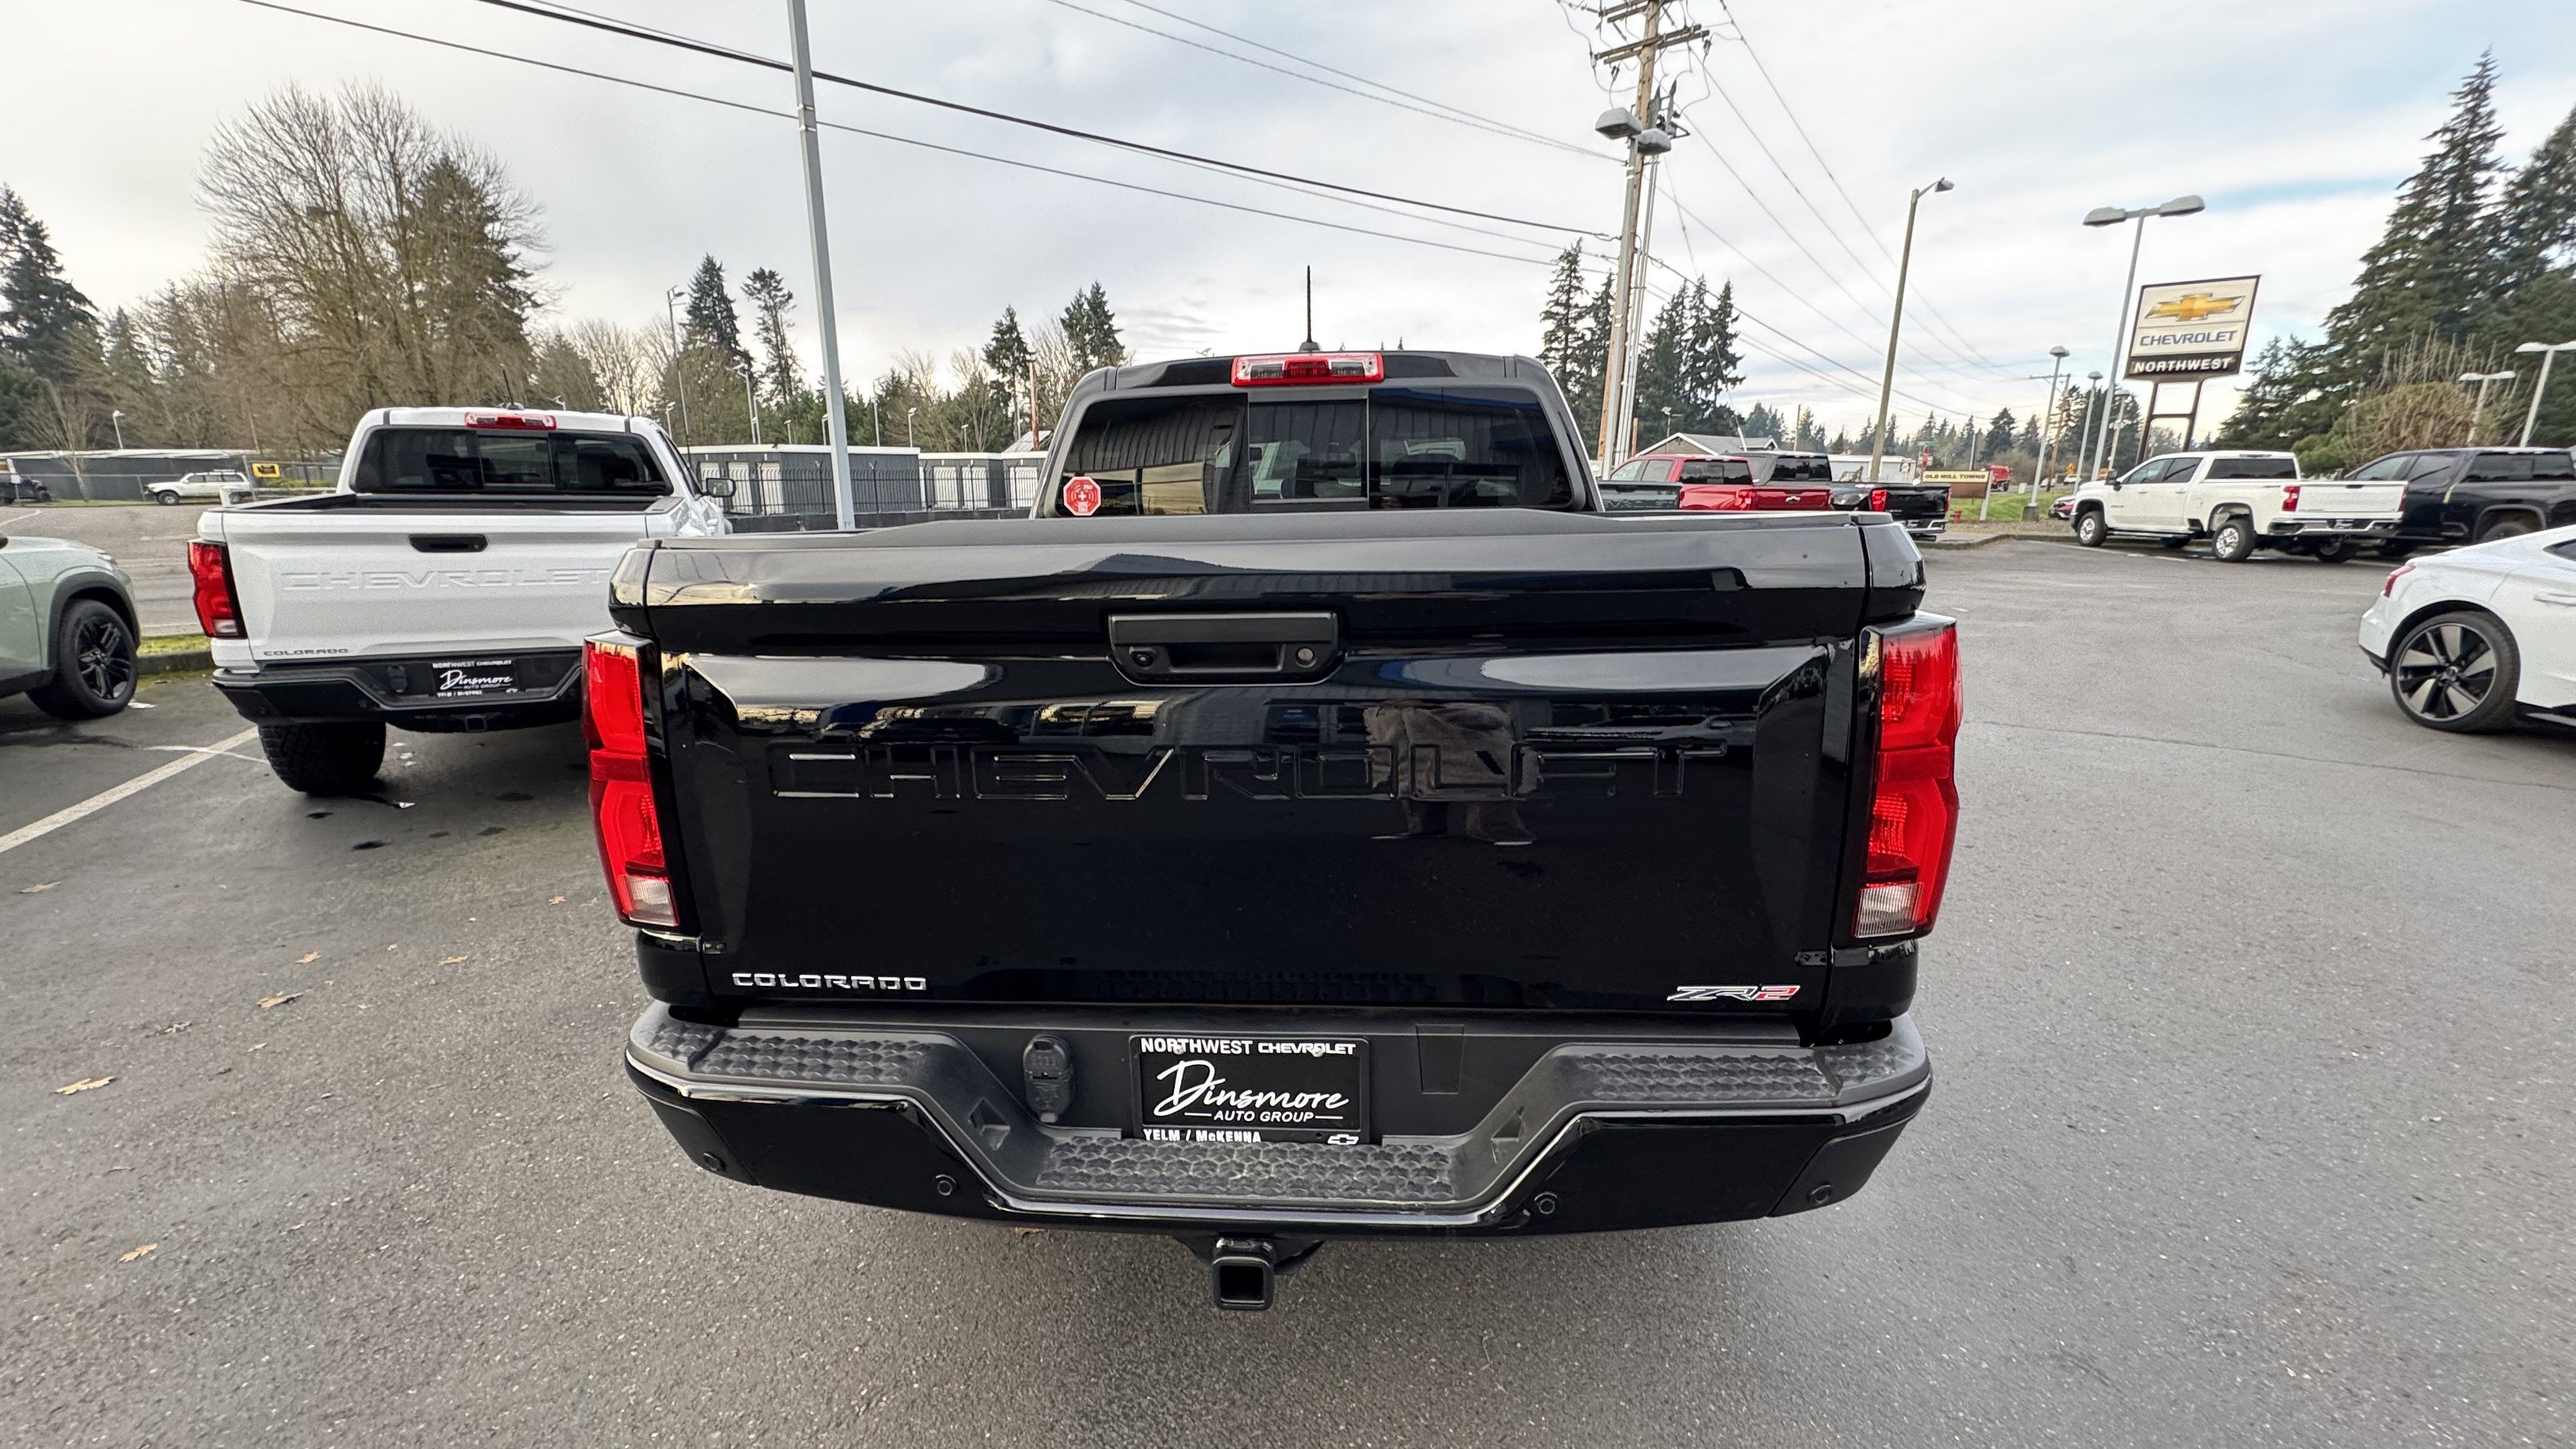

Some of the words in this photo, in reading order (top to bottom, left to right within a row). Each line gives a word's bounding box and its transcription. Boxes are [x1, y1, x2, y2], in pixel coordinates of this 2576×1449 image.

[2140, 330, 2238, 346] CHEVROLET
[2133, 356, 2234, 373] NORTHWEST
[280, 568, 611, 591] CHEVROLET
[439, 670, 513, 691] Dinsmore
[767, 742, 1728, 801] CHEVROLET
[732, 972, 926, 990] COLORADO
[1666, 985, 1801, 1002] ZR2
[1140, 1038, 1254, 1055] NORTHWEST
[1257, 1042, 1356, 1055] CHEVROLET
[1153, 1059, 1350, 1117] Dinsmore
[1214, 1110, 1256, 1122] AUTO
[1260, 1111, 1314, 1123] GROUP
[1143, 1128, 1181, 1142] YELM
[1195, 1130, 1262, 1143] McKENNA
